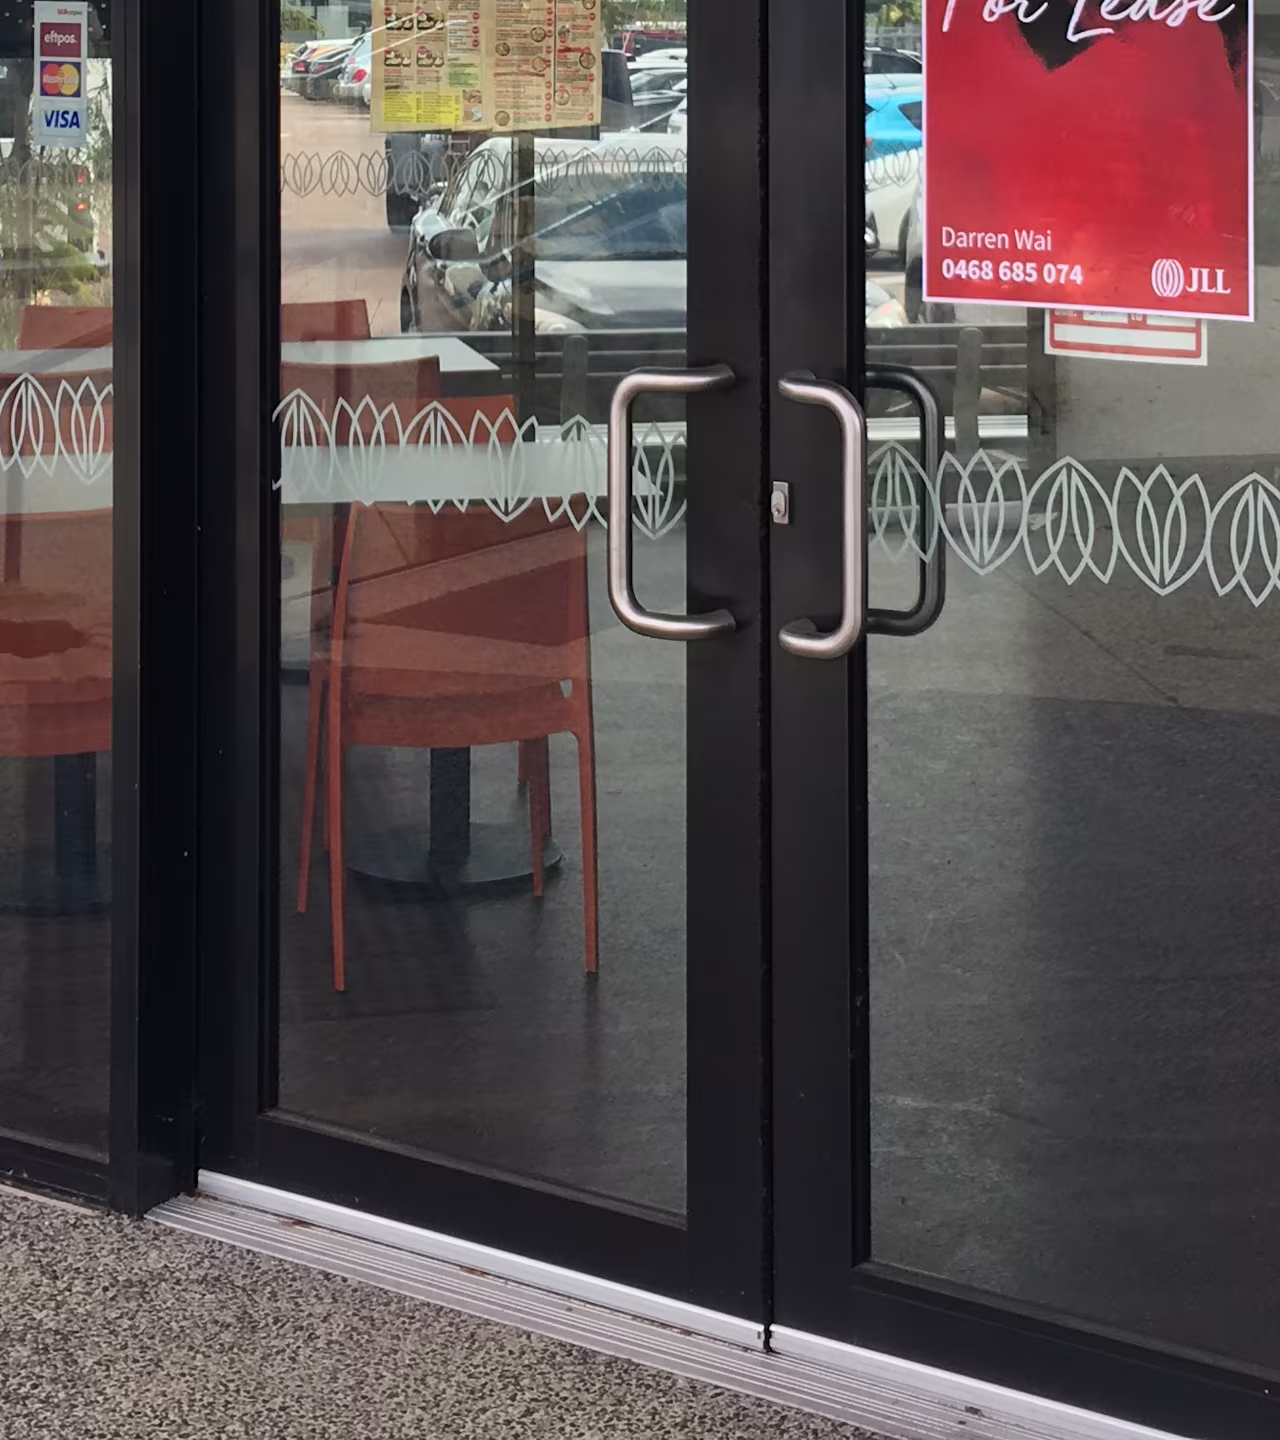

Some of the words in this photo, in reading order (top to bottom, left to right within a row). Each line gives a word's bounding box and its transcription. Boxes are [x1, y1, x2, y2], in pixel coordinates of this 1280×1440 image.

[44, 109, 81, 129] VISA
[941, 226, 1009, 249] Darren
[1014, 228, 1052, 252] Wai
[941, 258, 993, 281] 0468
[998, 261, 1038, 283] 685
[1043, 263, 1084, 285] 074
[1185, 267, 1231, 295] JLL
